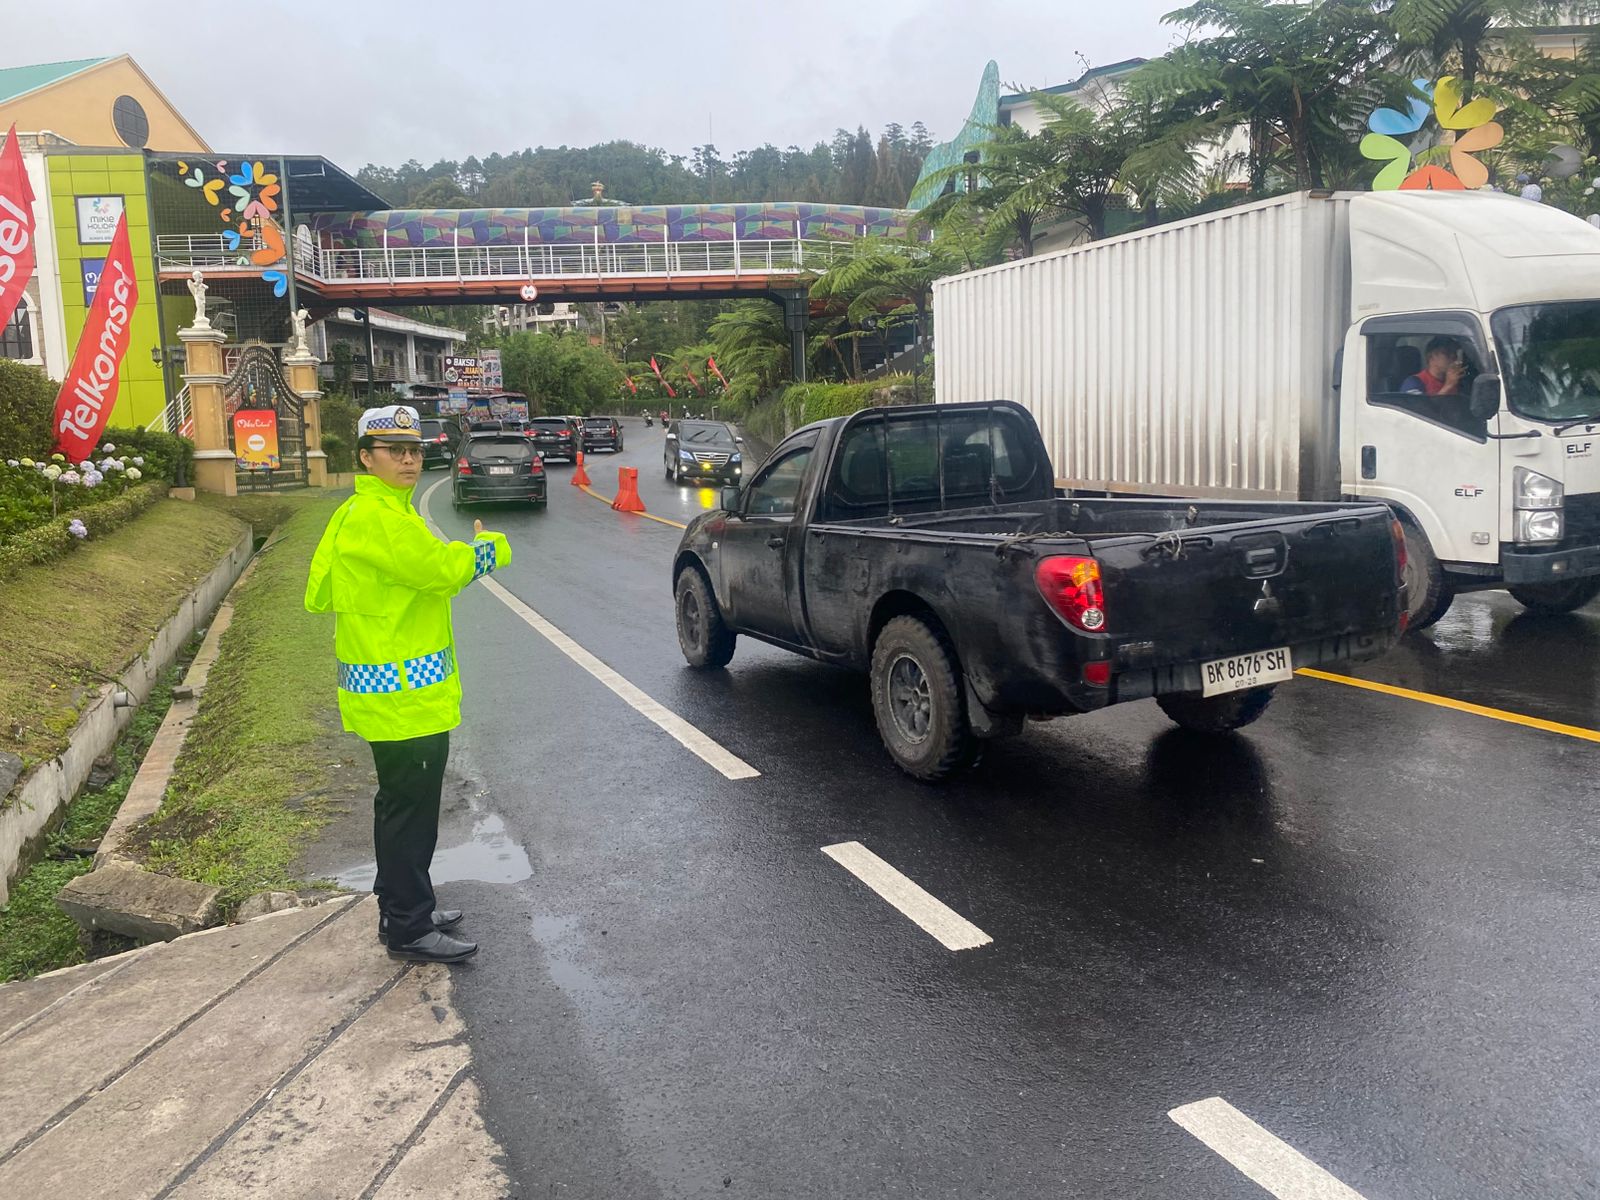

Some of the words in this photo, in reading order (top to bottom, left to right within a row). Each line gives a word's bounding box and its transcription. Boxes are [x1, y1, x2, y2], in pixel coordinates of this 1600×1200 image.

[60, 260, 133, 441] Telkomsel
[453, 358, 475, 367] BAKSO
[1567, 443, 1592, 454] ELF
[1454, 488, 1484, 498] ELF
[1207, 662, 1225, 684] BK
[1228, 655, 1261, 679] 8676
[1266, 650, 1286, 671] SH
